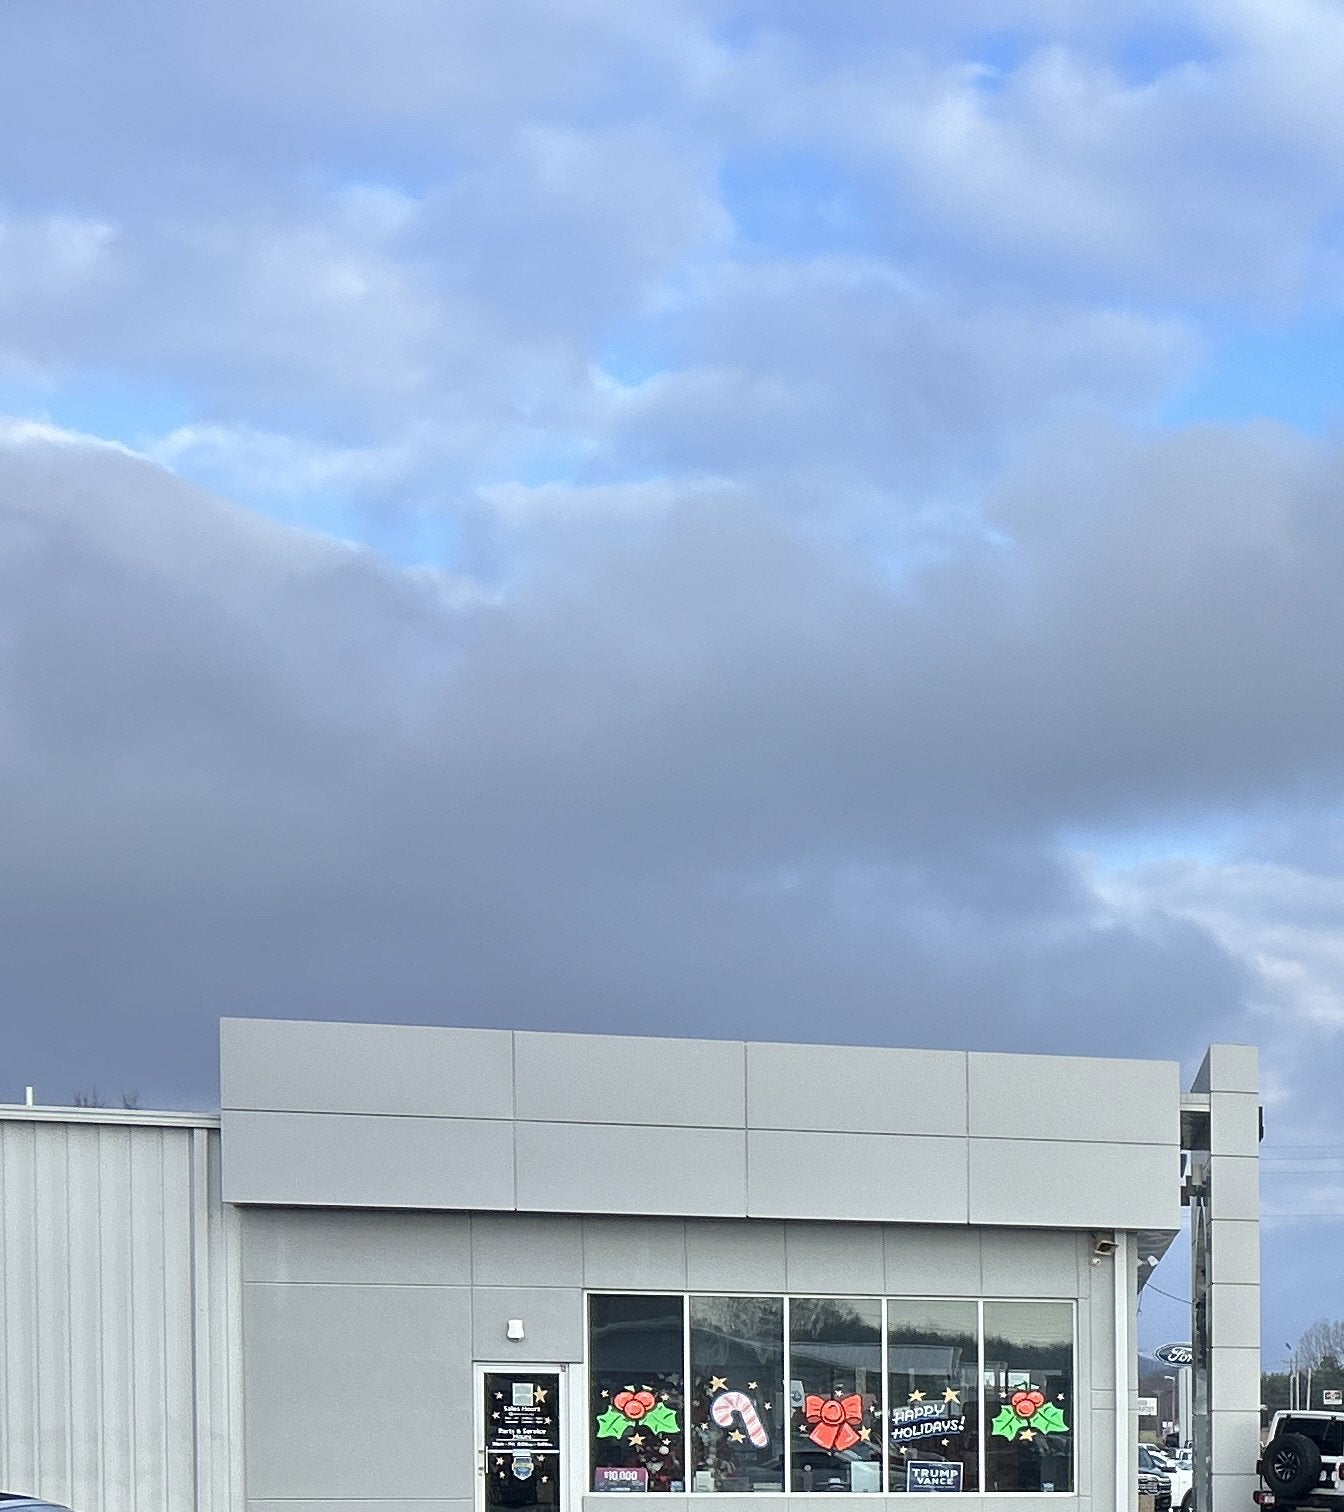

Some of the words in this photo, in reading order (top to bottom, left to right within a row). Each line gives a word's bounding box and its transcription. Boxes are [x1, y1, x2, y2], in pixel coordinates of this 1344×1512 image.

[1167, 1346, 1193, 1363] For
[892, 1403, 946, 1425] HAPPY
[891, 1415, 966, 1440] HOLIDAYS!
[911, 1468, 959, 1478] TRUMP
[917, 1477, 954, 1486] VANCE
